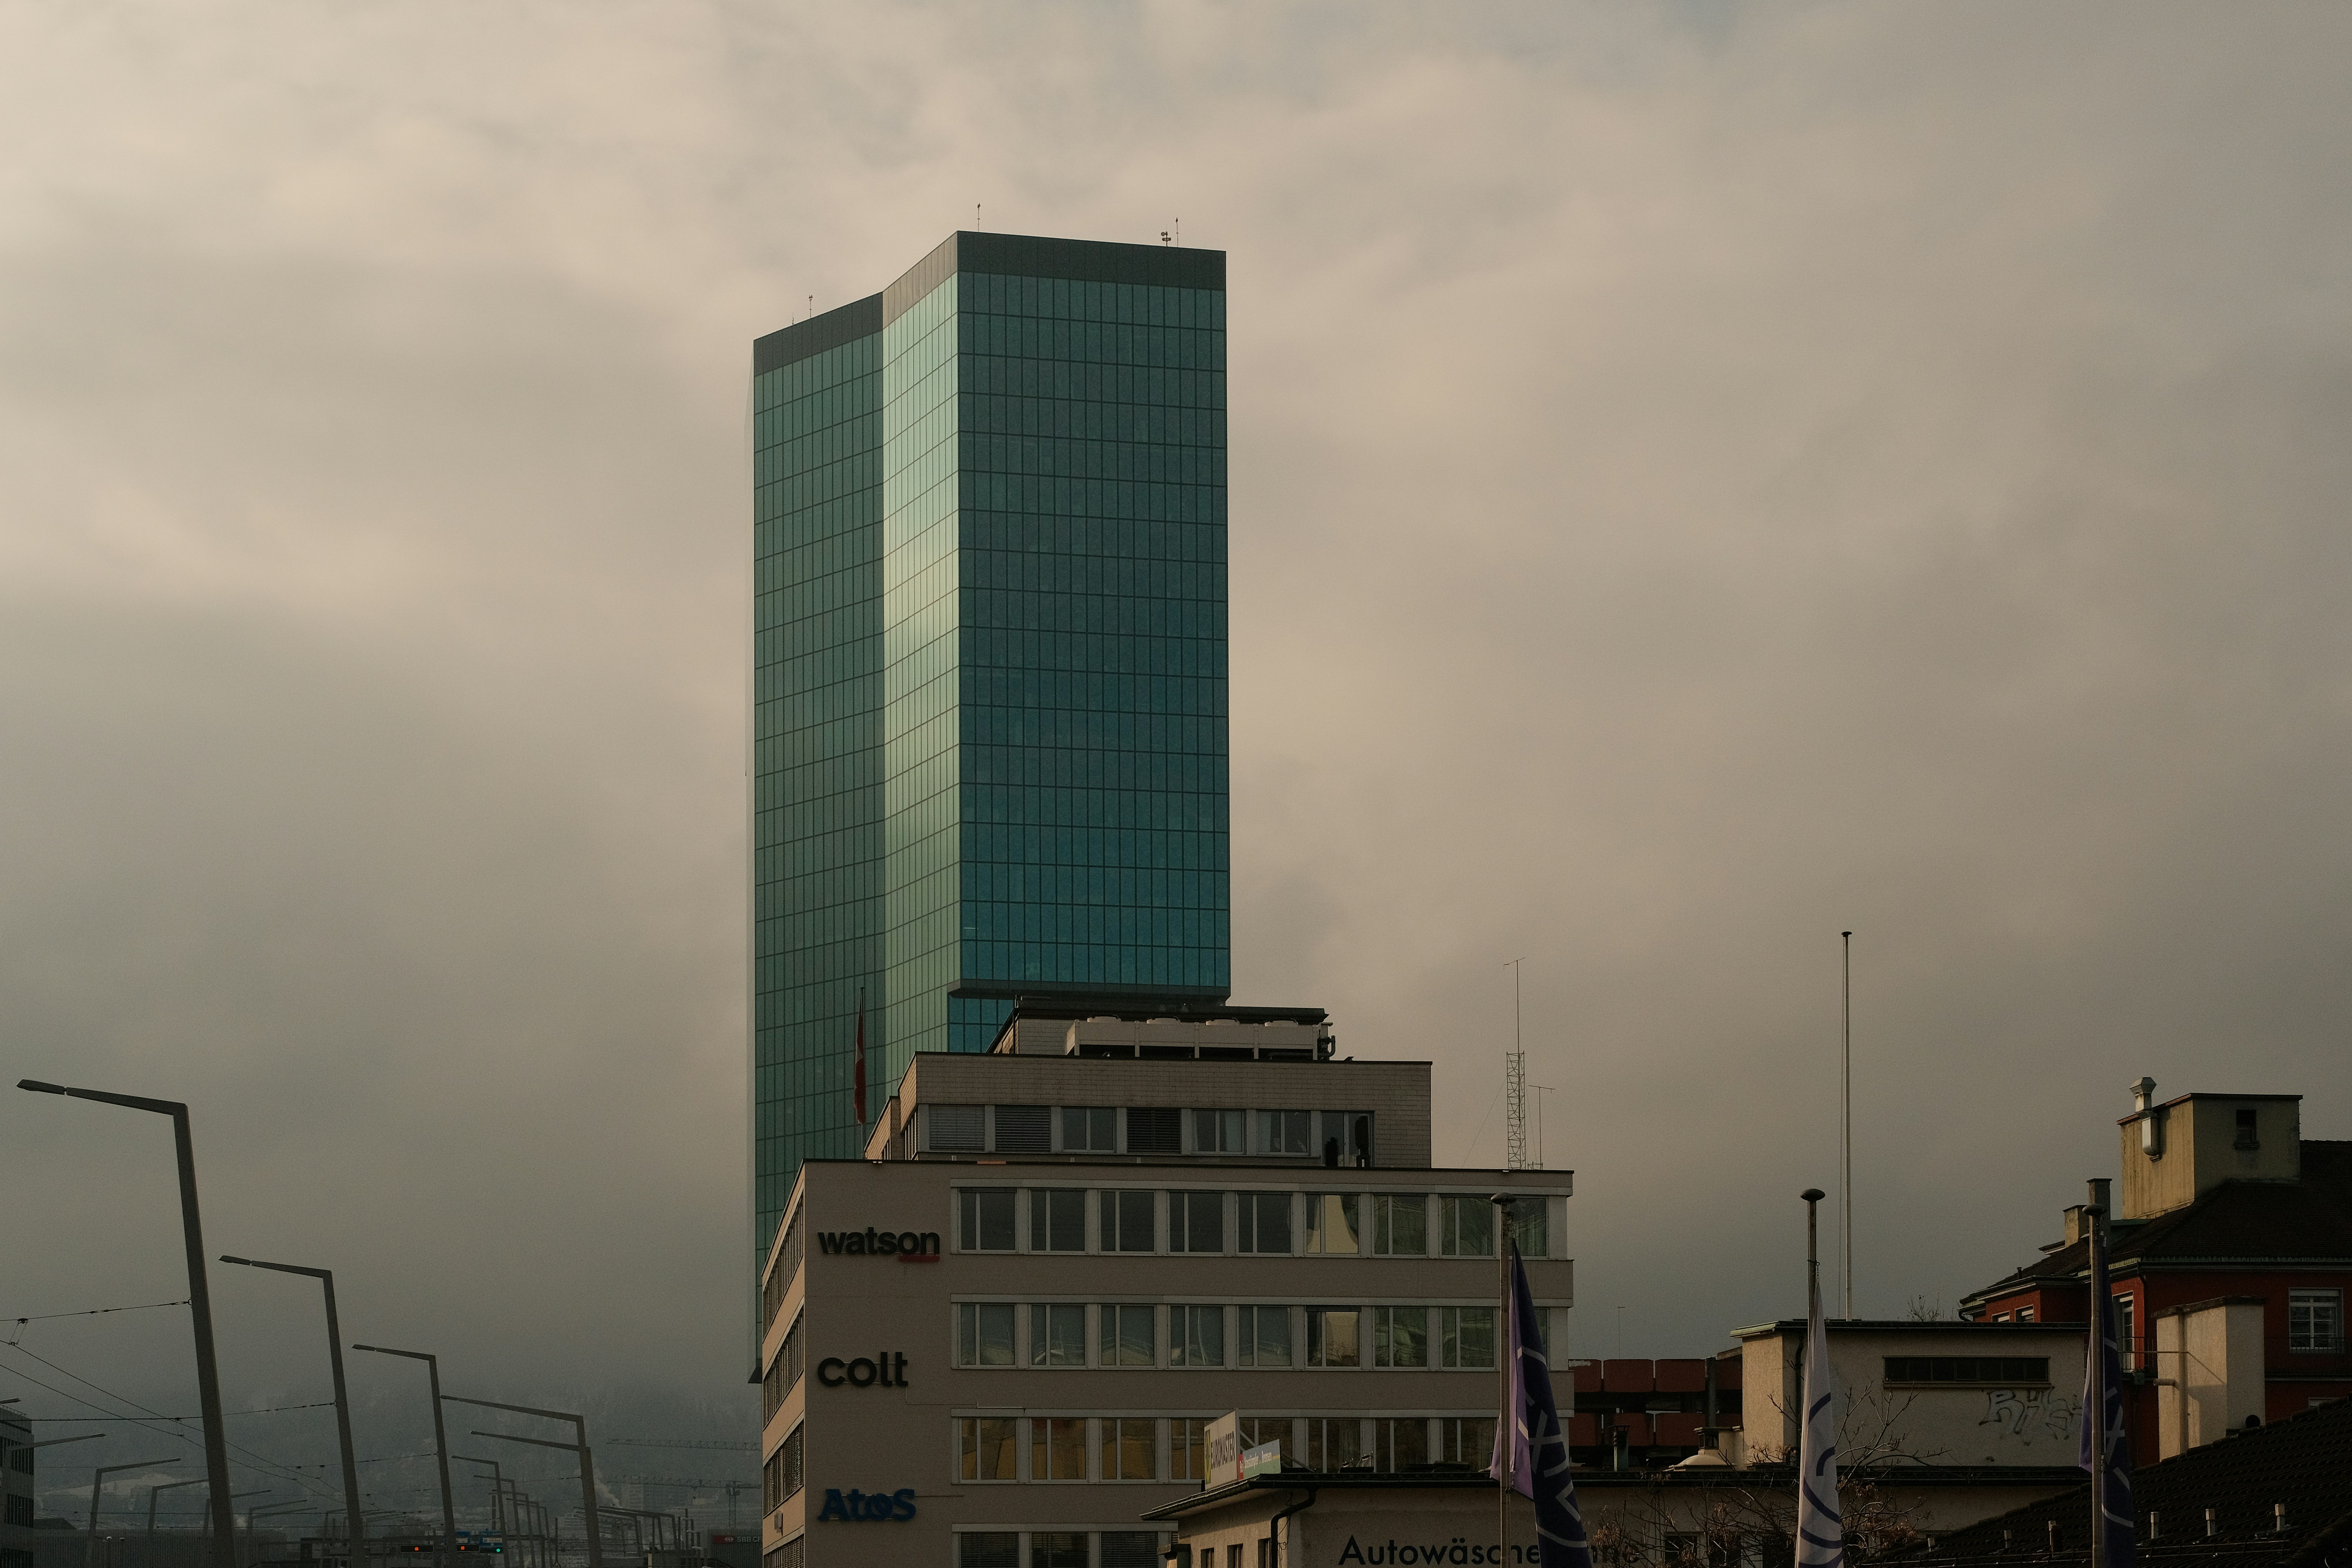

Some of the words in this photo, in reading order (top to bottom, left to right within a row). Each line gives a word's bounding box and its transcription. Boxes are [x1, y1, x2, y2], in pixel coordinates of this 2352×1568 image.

[818, 1227, 940, 1254] watson
[818, 1352, 908, 1387] colt
[1211, 1431, 1235, 1470] EUROMASTER
